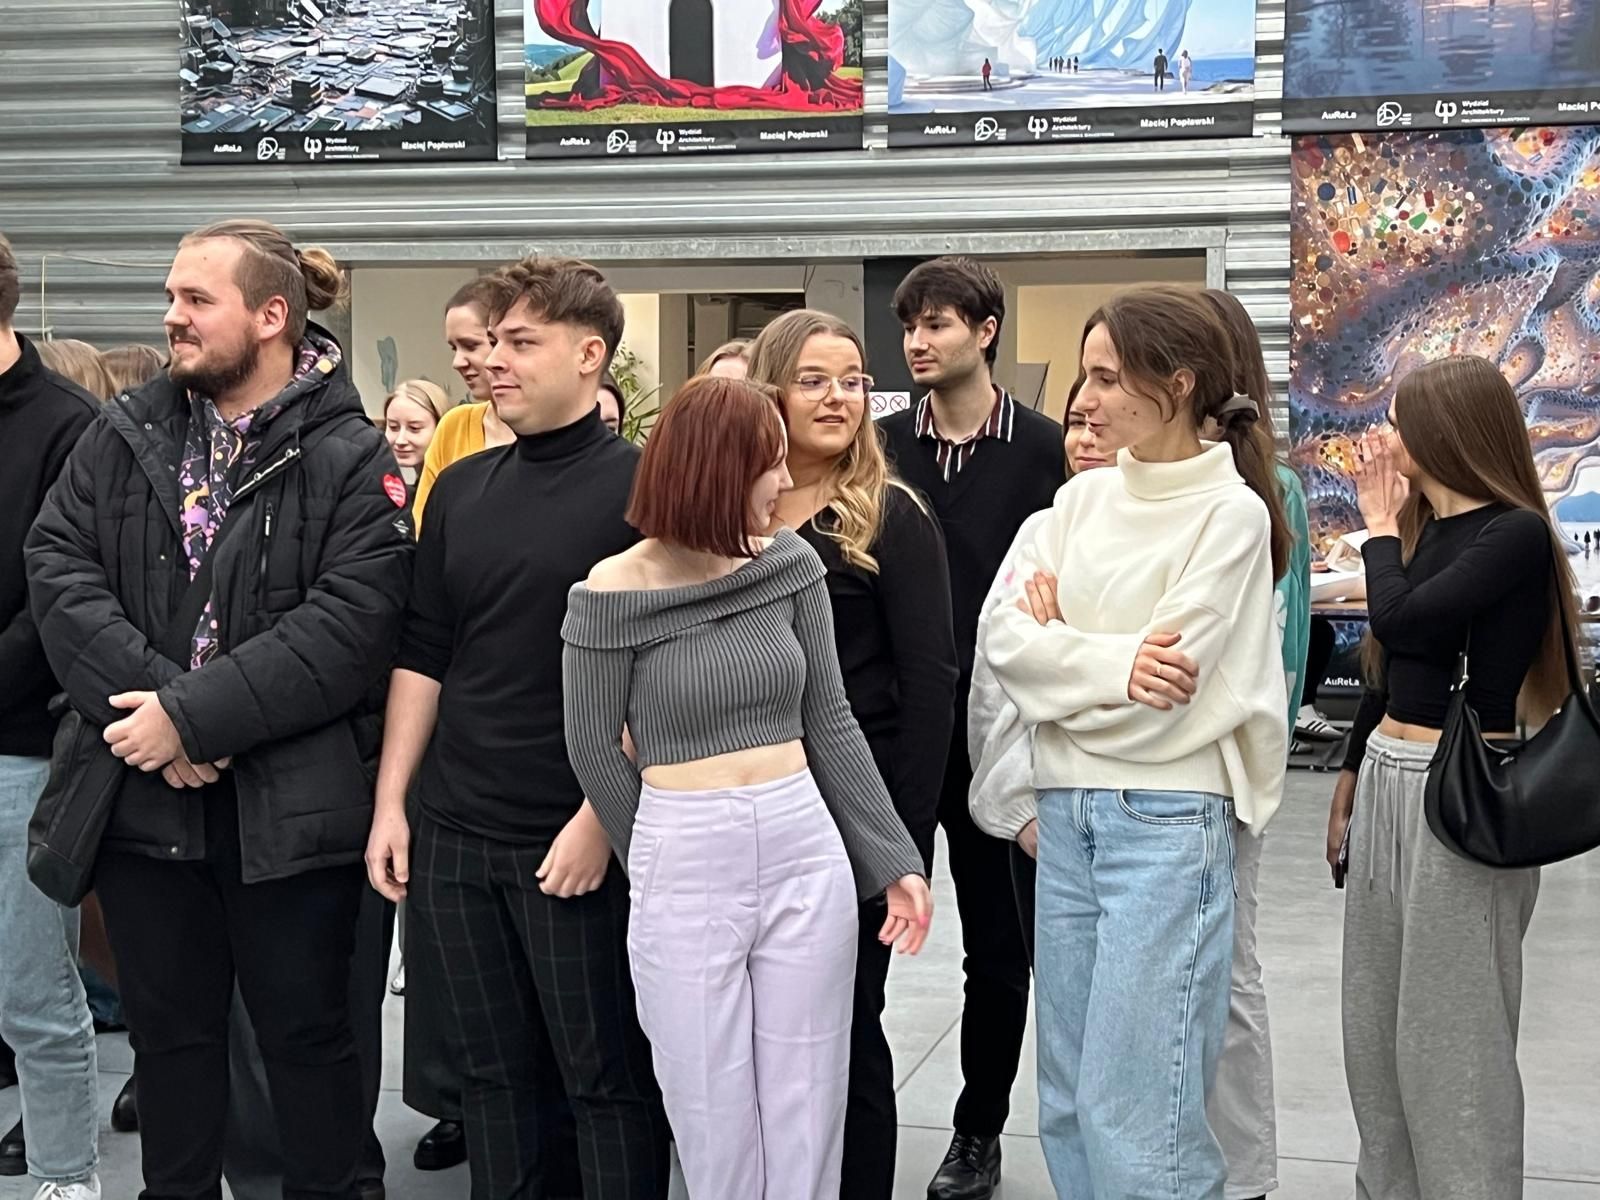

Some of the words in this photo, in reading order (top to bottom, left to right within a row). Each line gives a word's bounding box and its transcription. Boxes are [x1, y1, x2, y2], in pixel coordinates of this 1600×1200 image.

[1558, 101, 1589, 112] Maciej
[1140, 118, 1169, 129] Maciej
[760, 131, 786, 141] Maciej
[1324, 677, 1360, 686] AuReLa
